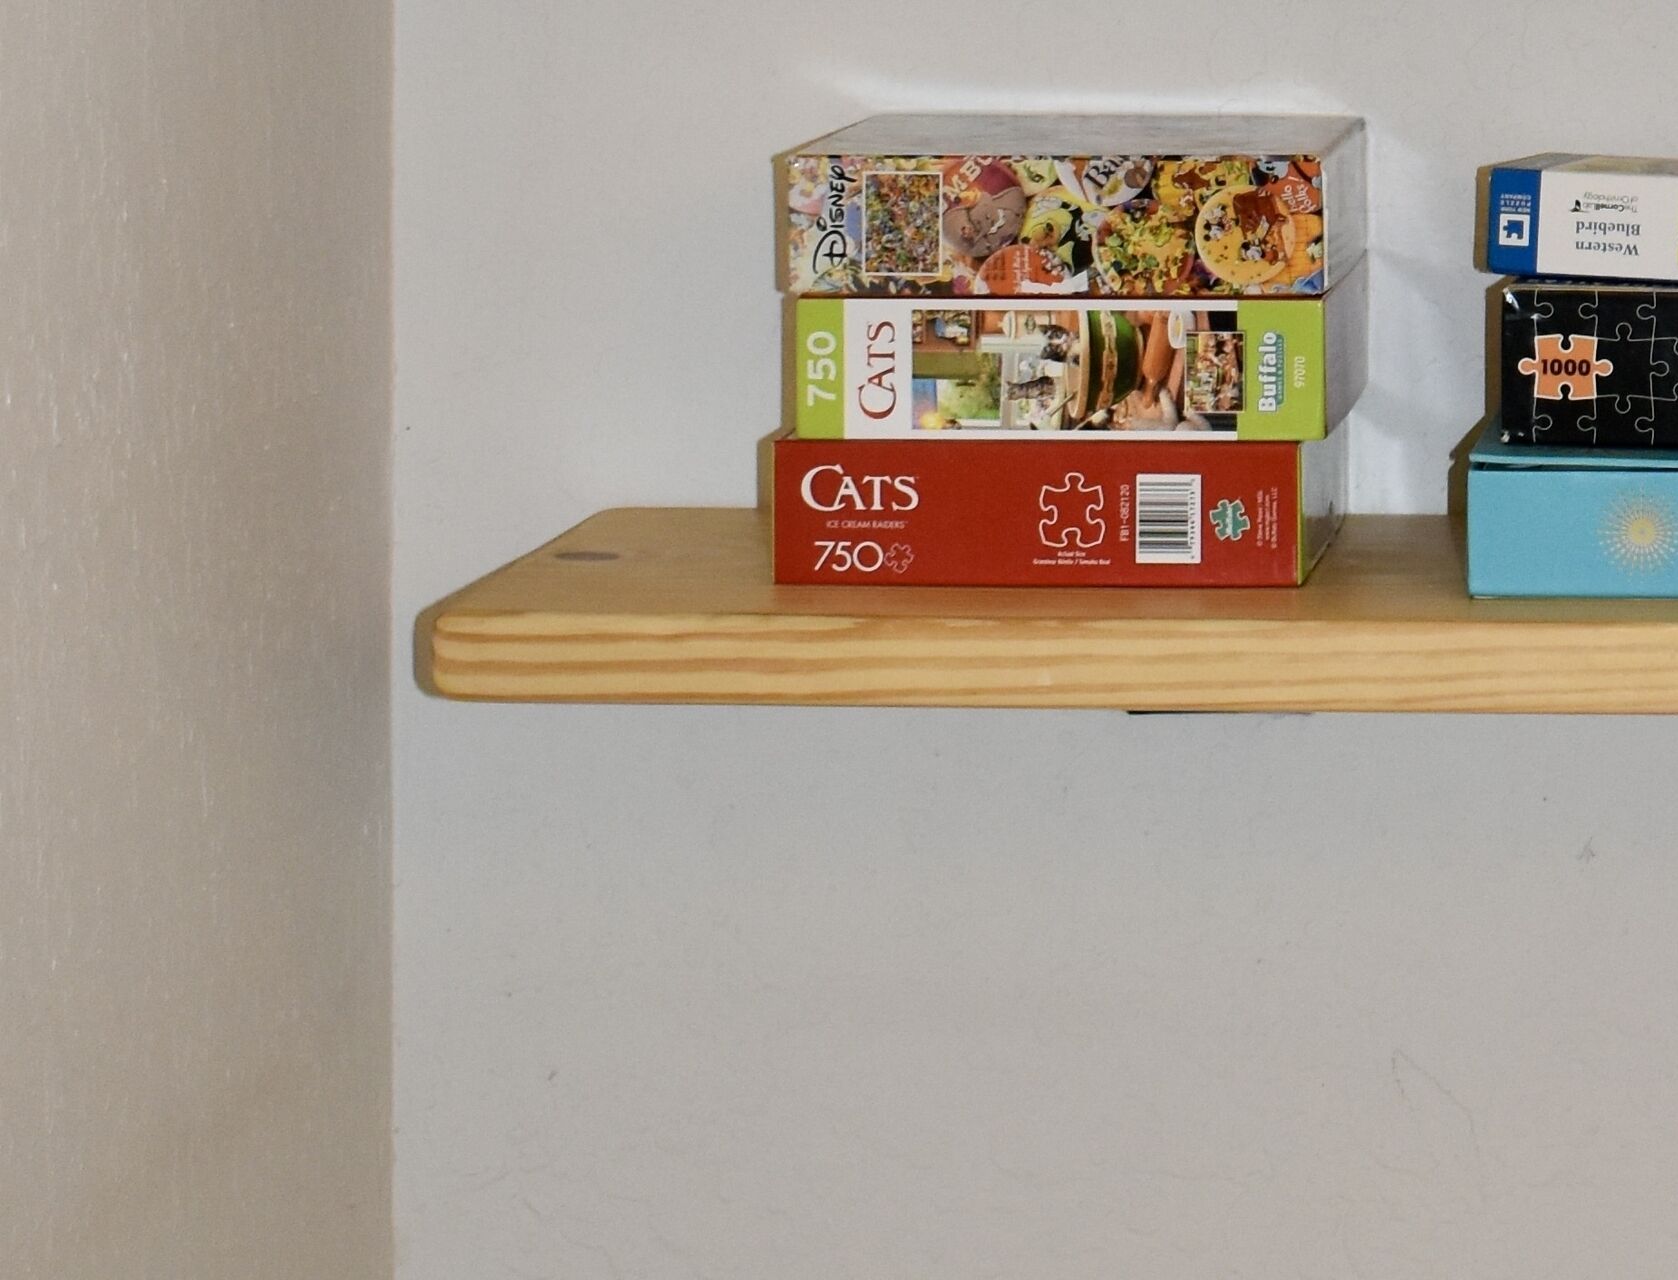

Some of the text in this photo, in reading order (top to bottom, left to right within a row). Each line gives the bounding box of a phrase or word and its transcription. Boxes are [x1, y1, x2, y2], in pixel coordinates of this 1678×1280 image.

[1576, 220, 1642, 236] Bluebird
[1575, 240, 1640, 256] Western
[806, 330, 838, 408] 750
[1258, 332, 1276, 412] Buffalo
[1294, 356, 1306, 389] 97070
[1540, 359, 1592, 377] 1000
[812, 542, 884, 572] 750
